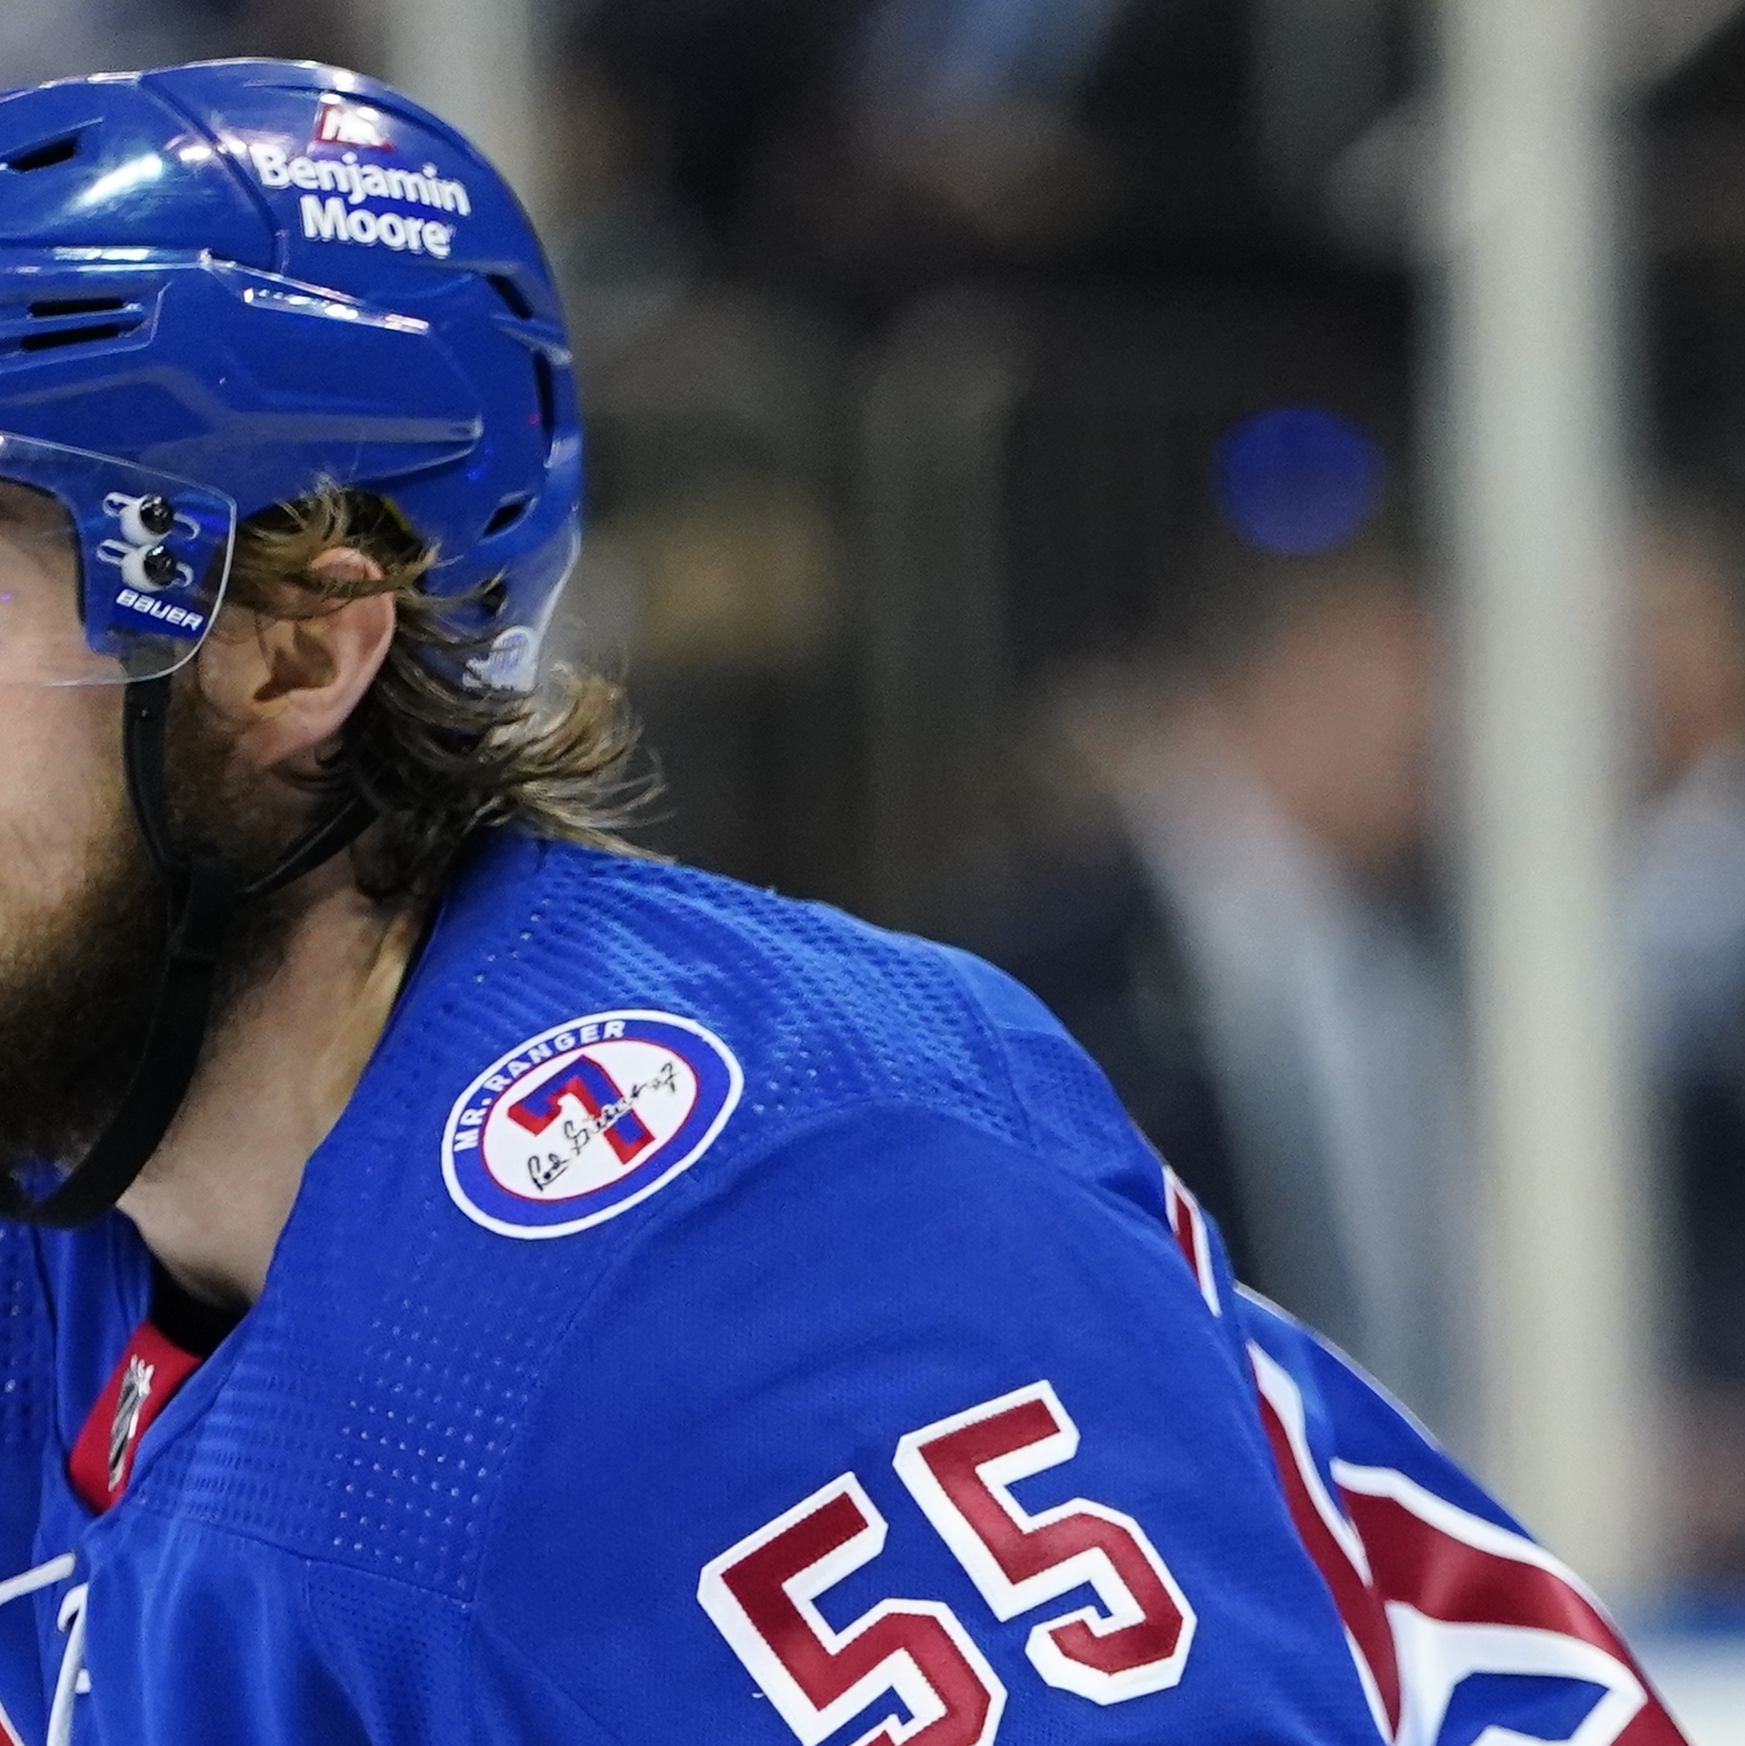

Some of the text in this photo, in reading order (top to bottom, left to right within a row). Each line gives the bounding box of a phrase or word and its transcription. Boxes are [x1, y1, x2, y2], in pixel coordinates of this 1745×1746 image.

[249, 143, 472, 217] Benjamin
[300, 194, 453, 260] Moore
[115, 588, 204, 632] BAUER
[483, 1020, 626, 1092] RANGER
